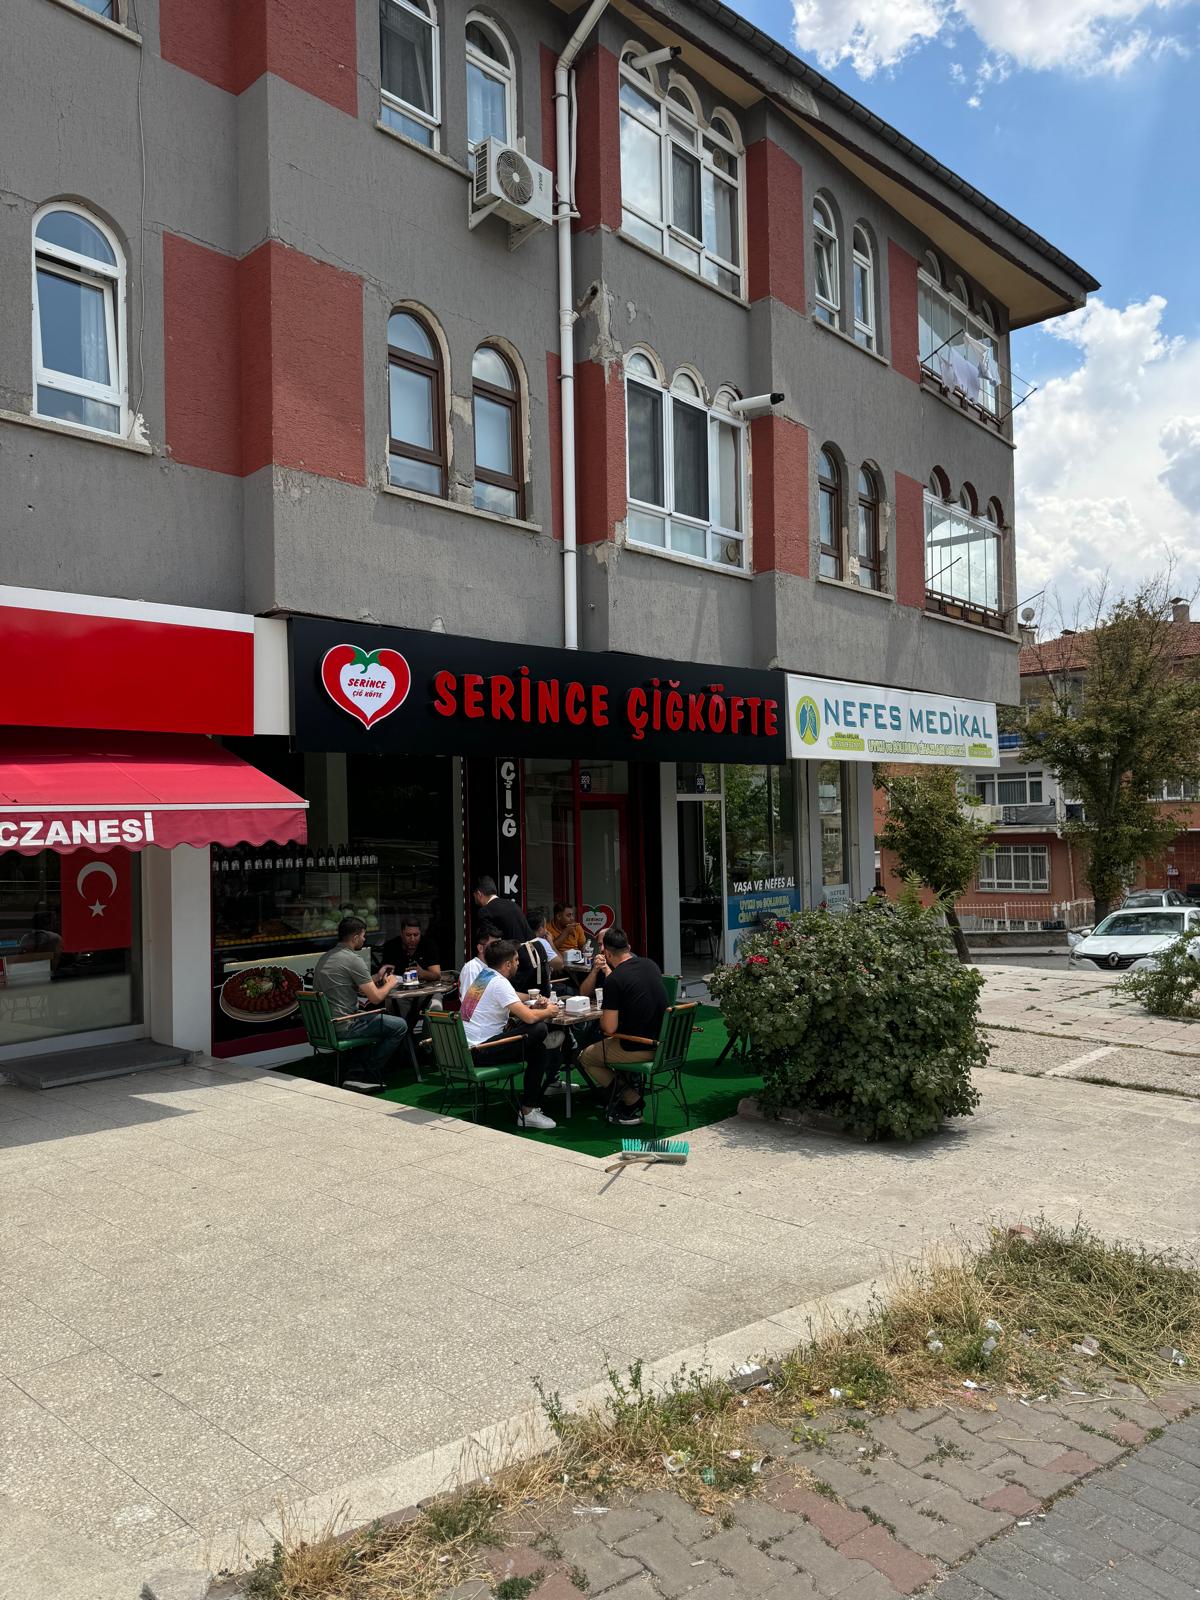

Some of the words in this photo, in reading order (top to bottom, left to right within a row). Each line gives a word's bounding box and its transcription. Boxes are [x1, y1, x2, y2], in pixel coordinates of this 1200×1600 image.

[348, 677, 387, 689] SERİNCE
[434, 666, 609, 727] SERİNCE
[627, 678, 778, 740] ÇİĞKÖFTE
[824, 698, 902, 731] NEFES
[909, 706, 993, 739] MEDİKAL
[733, 881, 752, 895] YAŞA
[754, 880, 763, 890] VE
[764, 878, 785, 889] NEFES
[786, 876, 795, 887] AL
